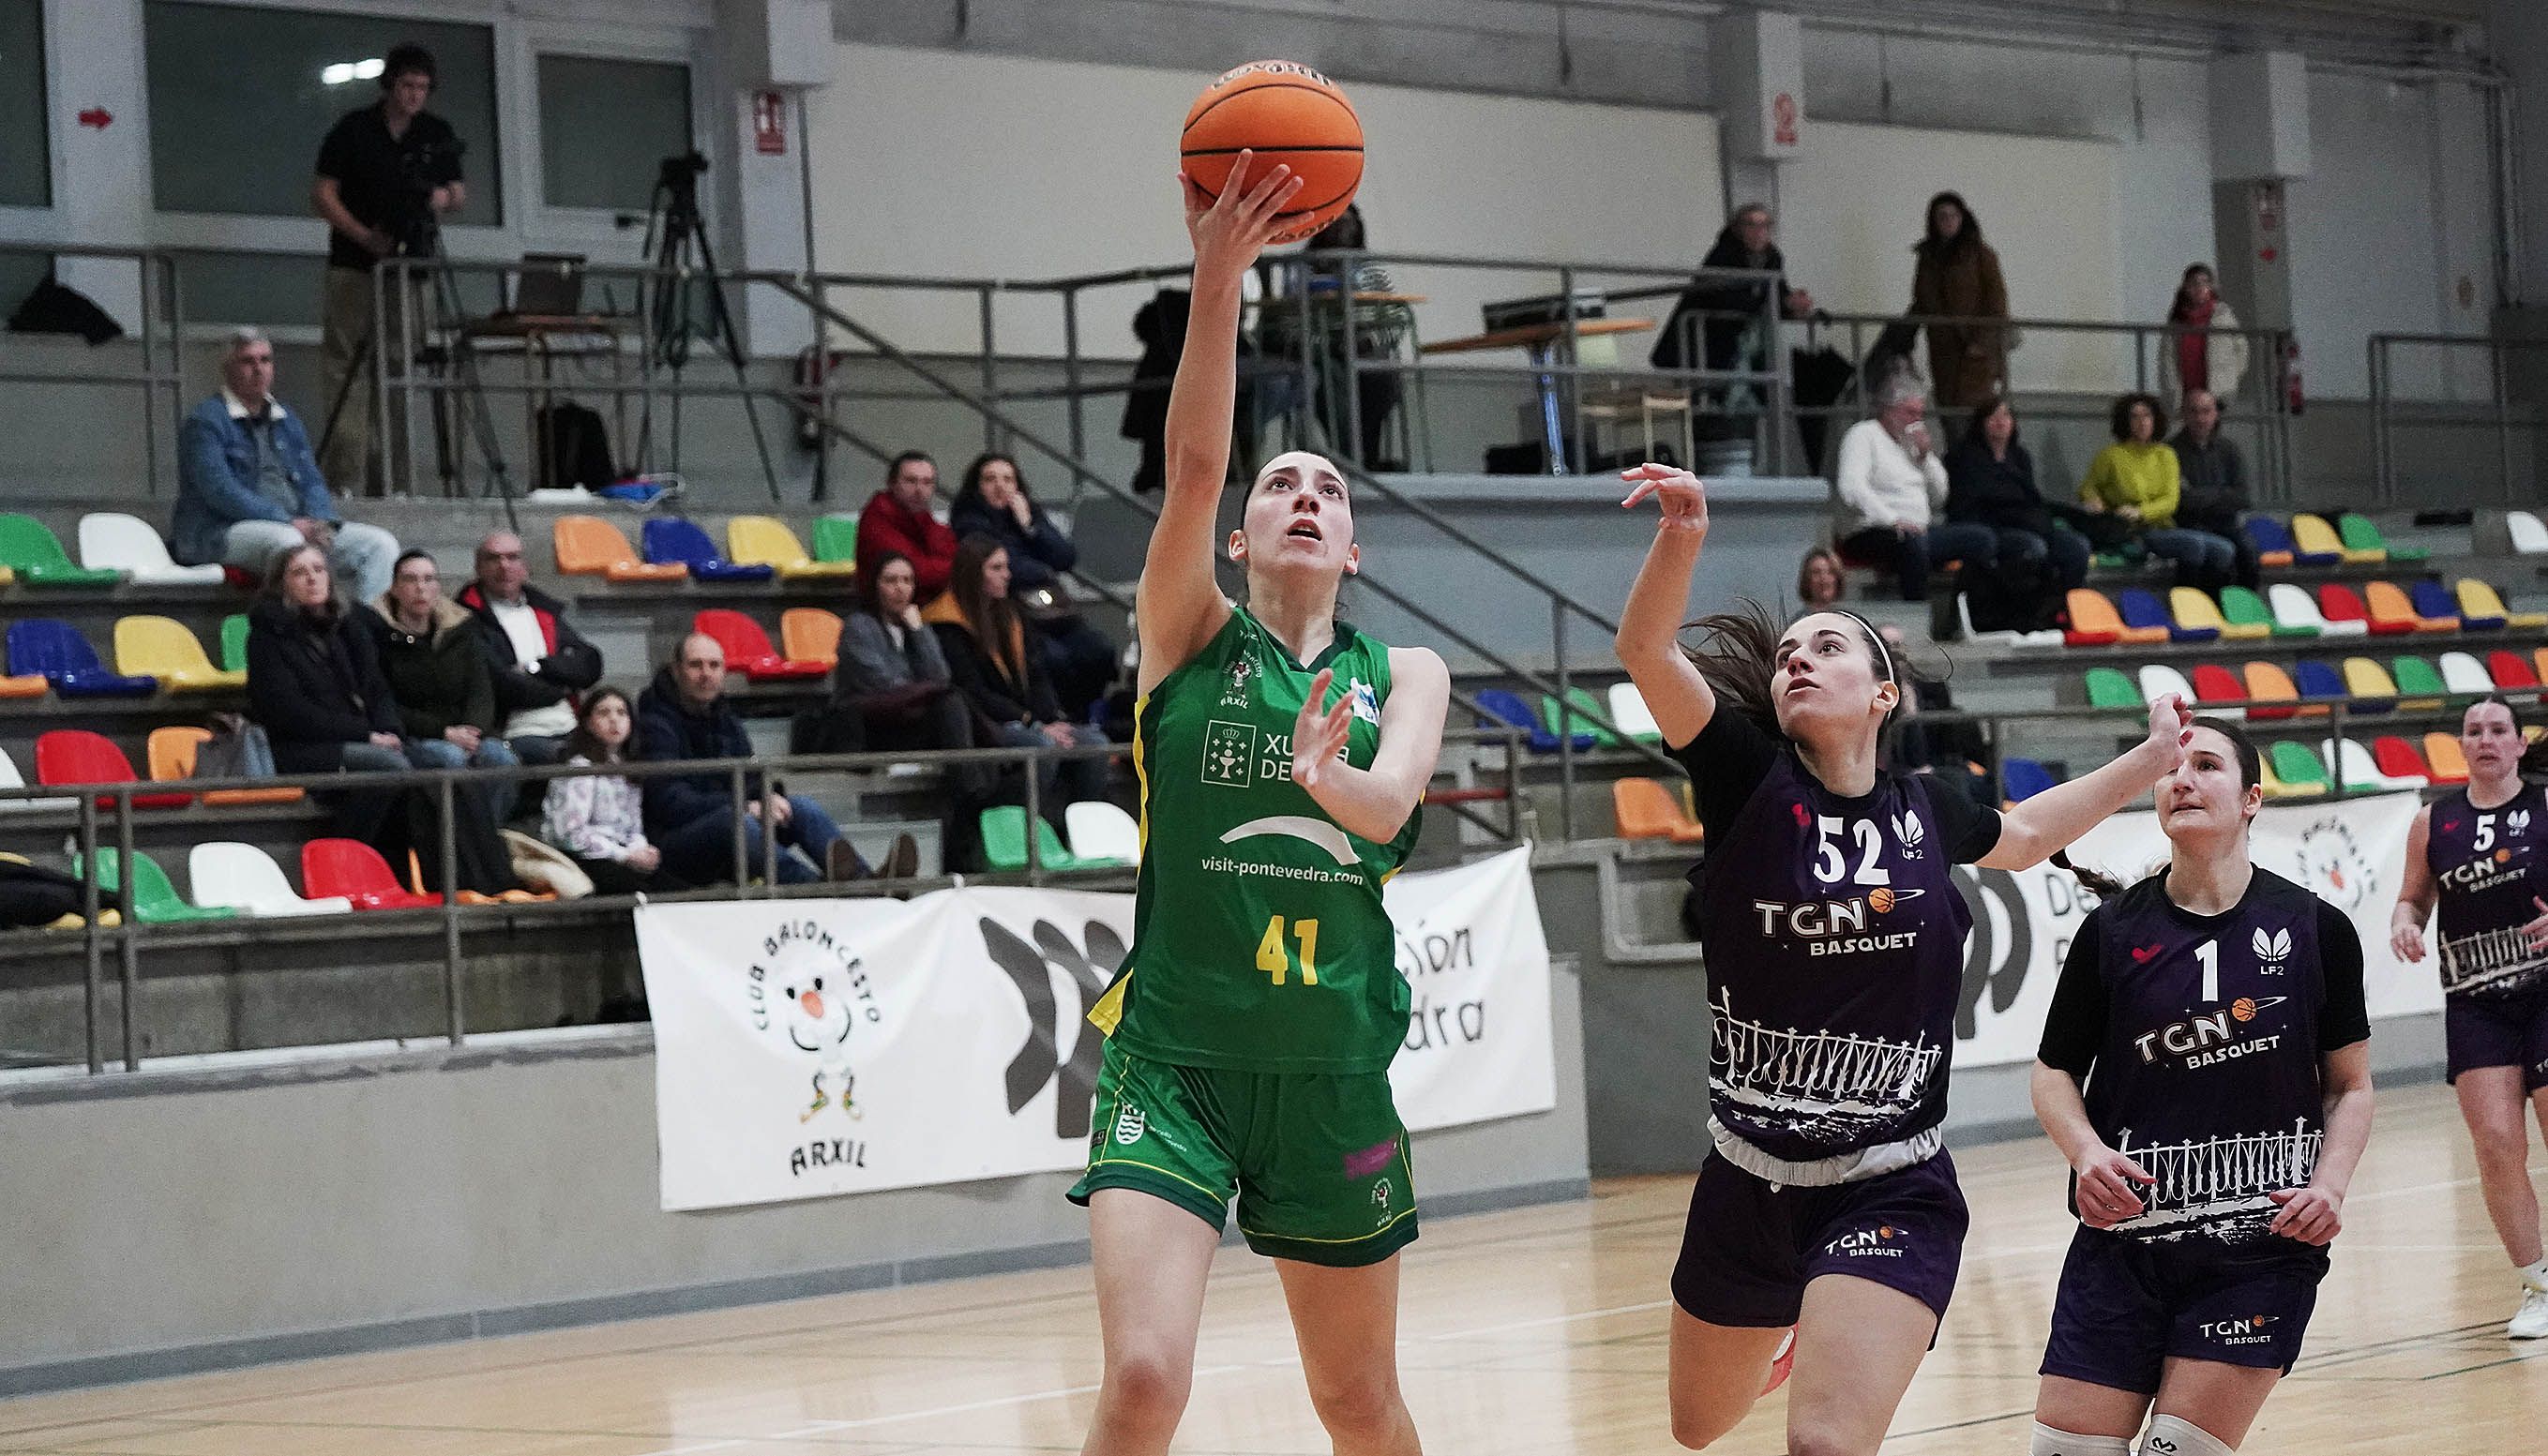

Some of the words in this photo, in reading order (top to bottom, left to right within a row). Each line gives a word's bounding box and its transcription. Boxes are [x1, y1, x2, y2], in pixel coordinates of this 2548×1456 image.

[1220, 696, 1248, 710] ARXIL
[1260, 758, 1292, 782] DE
[1813, 813, 1891, 885] 52
[2472, 814, 2496, 852] 5
[1201, 856, 1364, 886] visit-pontevedra.com
[2439, 857, 2495, 891] TGN
[1753, 897, 1868, 938] TGN
[1256, 914, 1319, 985] 41
[1810, 932, 1917, 956] BASQUET
[763, 920, 882, 1024] BALONCESTO
[2194, 938, 2219, 1001] 1
[2260, 966, 2284, 976] LF2
[749, 965, 770, 1031] CLUB
[2133, 1009, 2233, 1065] TGN
[2186, 1035, 2280, 1070] BASQUET
[791, 1137, 867, 1177] ARXIL
[1824, 1230, 1877, 1254] TGN
[1849, 1247, 1904, 1258] BASQUET
[2199, 1319, 2251, 1338] TGN
[2225, 1335, 2271, 1345] BASQUET
